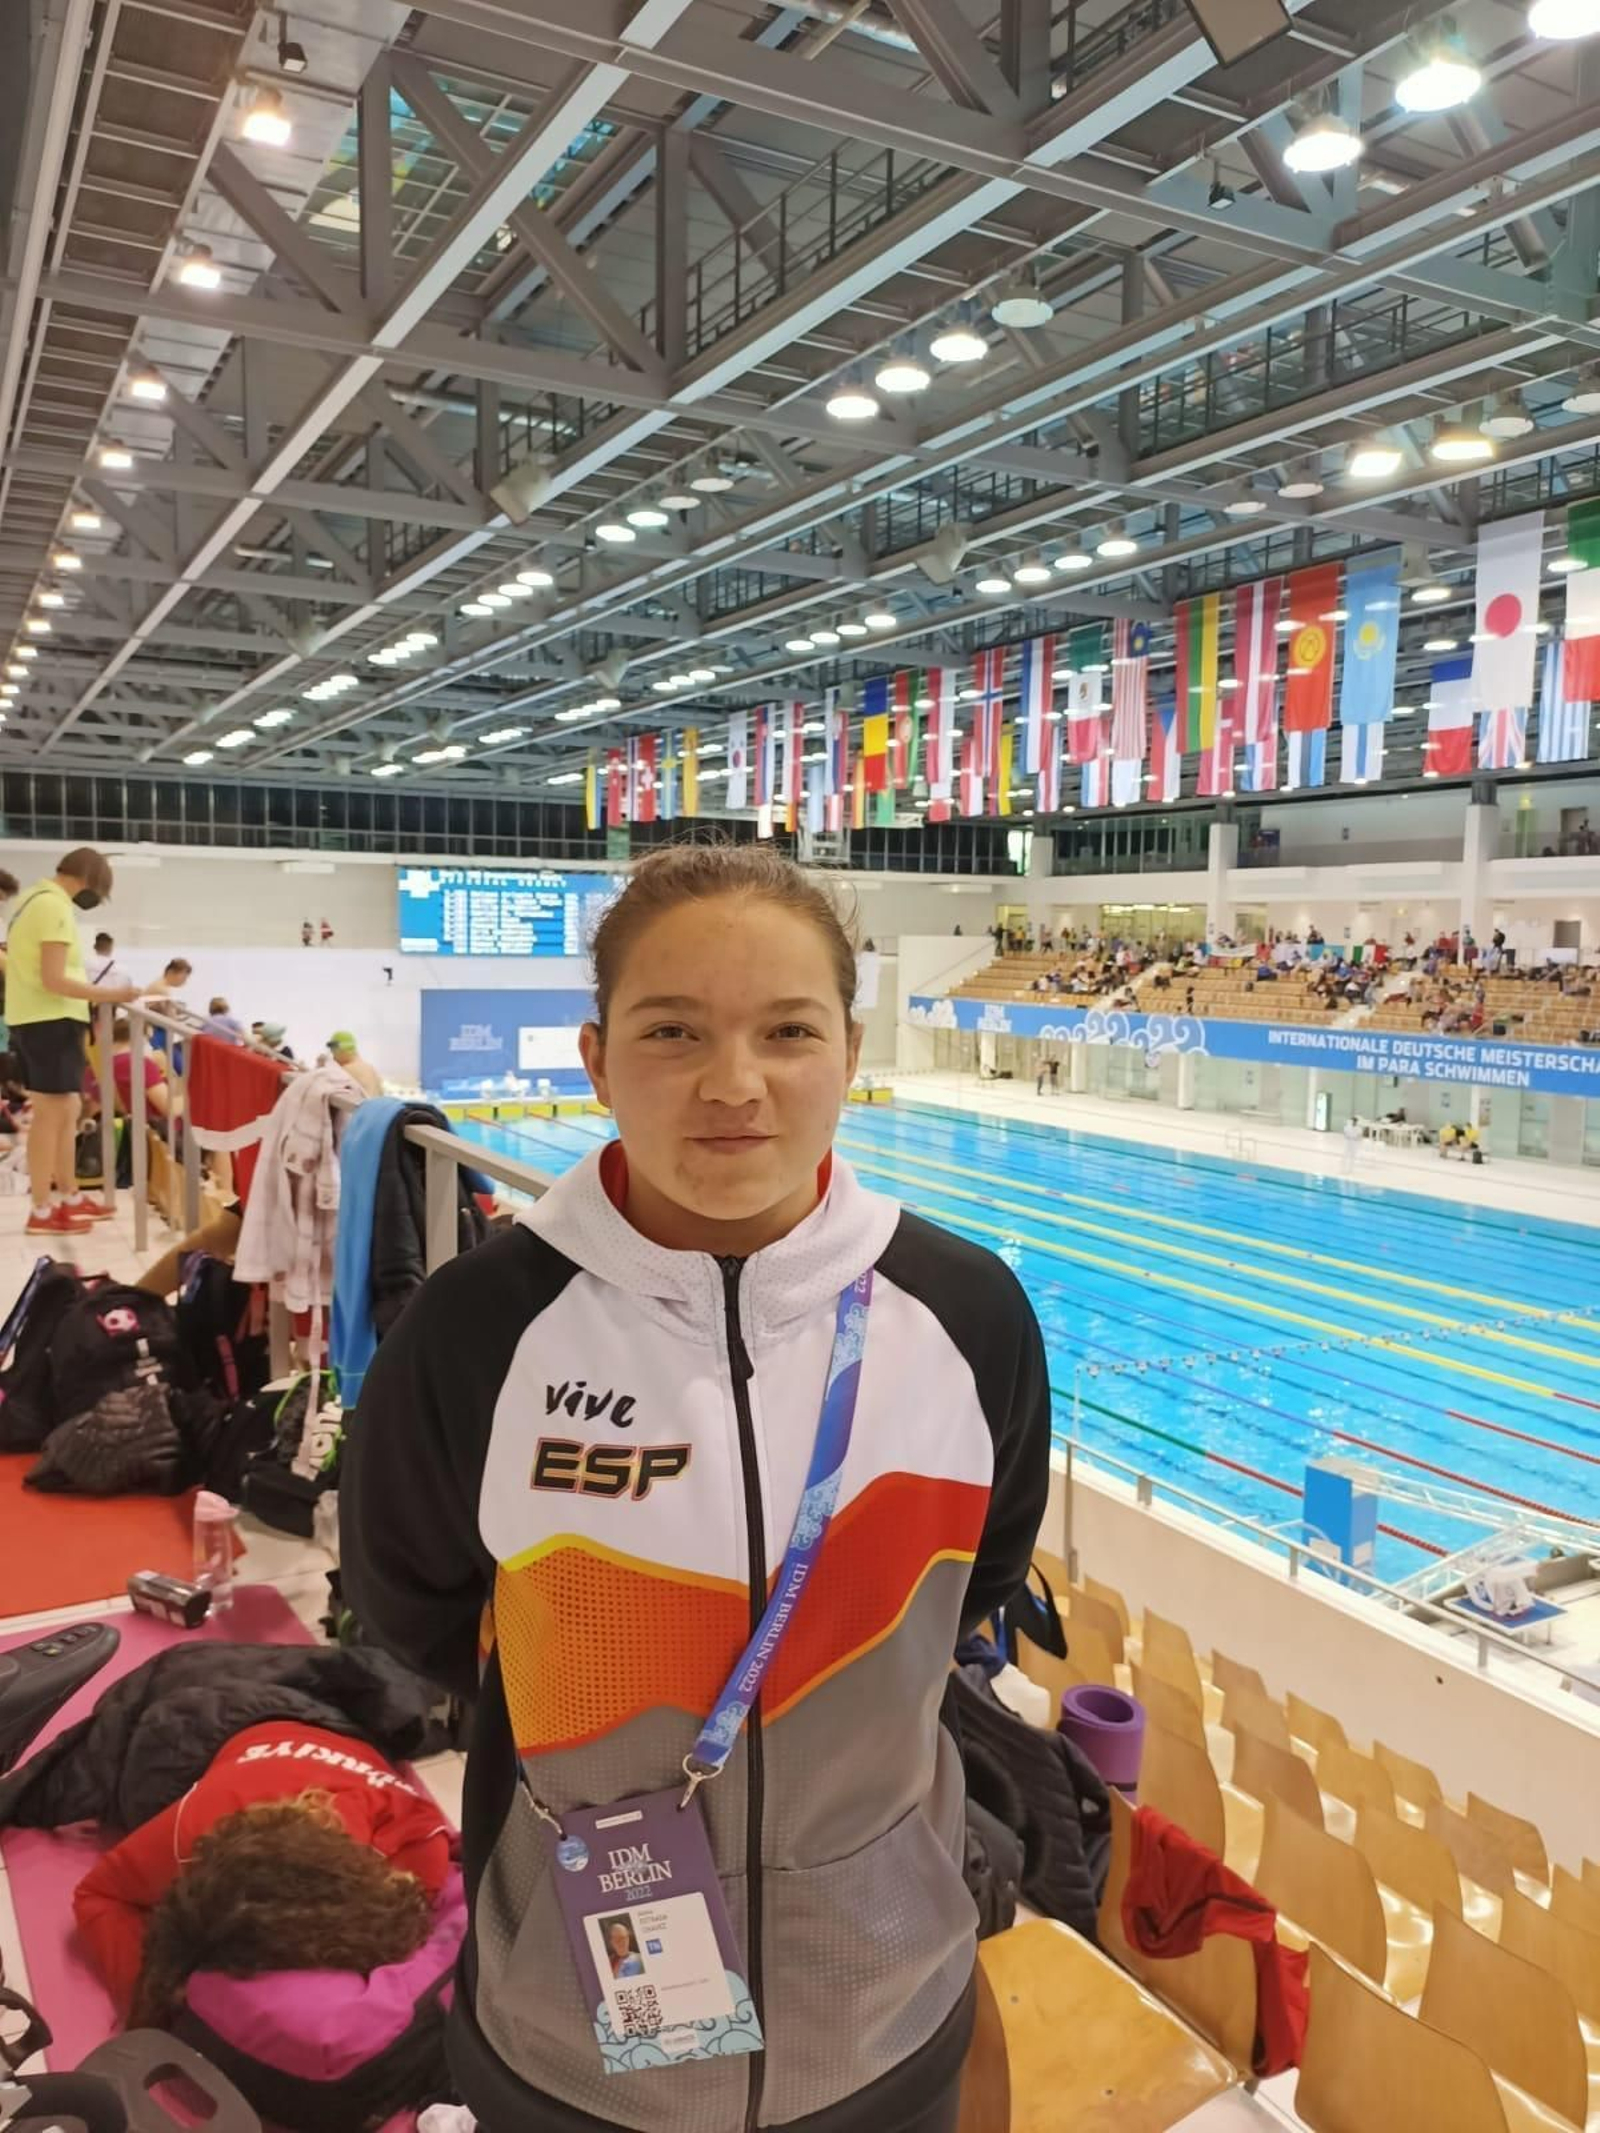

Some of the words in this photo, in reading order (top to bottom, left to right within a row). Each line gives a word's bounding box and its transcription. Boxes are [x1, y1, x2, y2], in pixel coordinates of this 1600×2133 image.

[1268, 1030, 1388, 1053] INTERNATIONALE
[1392, 1040, 1475, 1062] DEUTSCHE
[1356, 1055, 1374, 1070] IM
[1378, 1057, 1421, 1075] PARA
[1424, 1061, 1530, 1087] SCHWIMMEN
[530, 1437, 692, 1501] ESP
[785, 1563, 809, 1598] IDM
[756, 1603, 793, 1660] BERLIN
[738, 1660, 764, 1692] 2022
[607, 1843, 653, 1870] IDM
[597, 1860, 673, 1893] BERLIN
